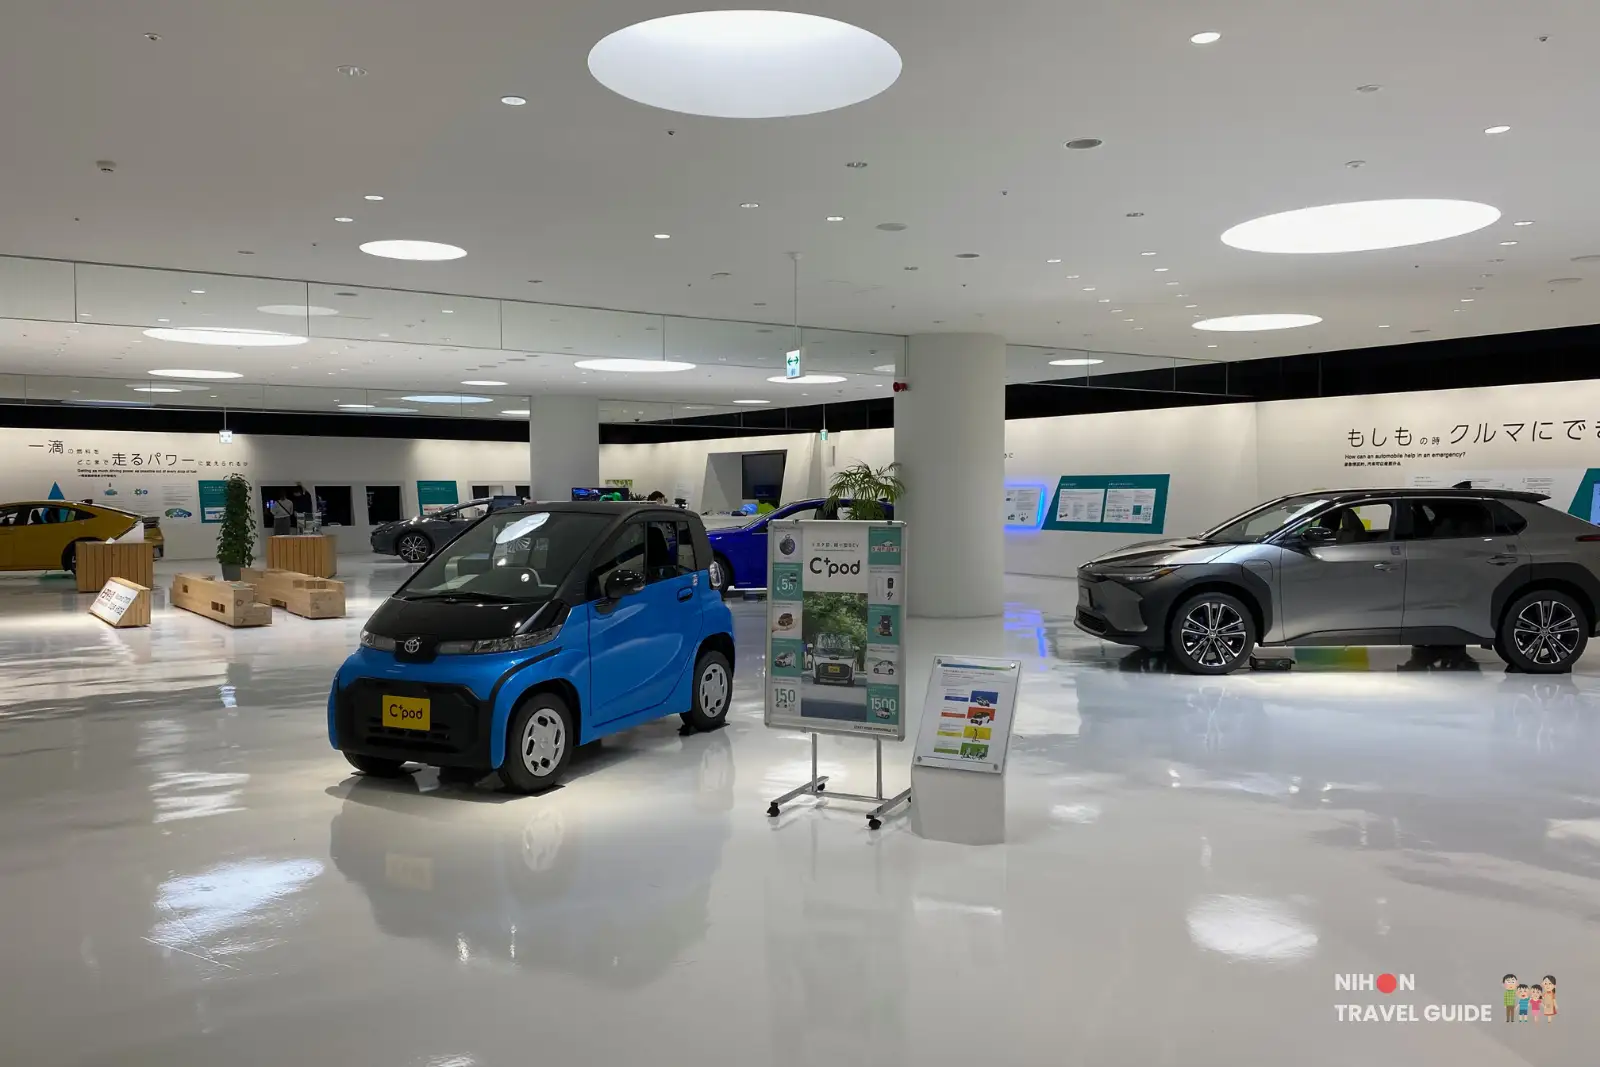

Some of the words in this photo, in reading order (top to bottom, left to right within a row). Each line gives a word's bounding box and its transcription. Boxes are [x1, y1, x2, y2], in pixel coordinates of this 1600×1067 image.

[1348, 419, 1600, 448] もしもの時クルマにで
[774, 688, 796, 703] 150
[870, 697, 897, 711] 1500
